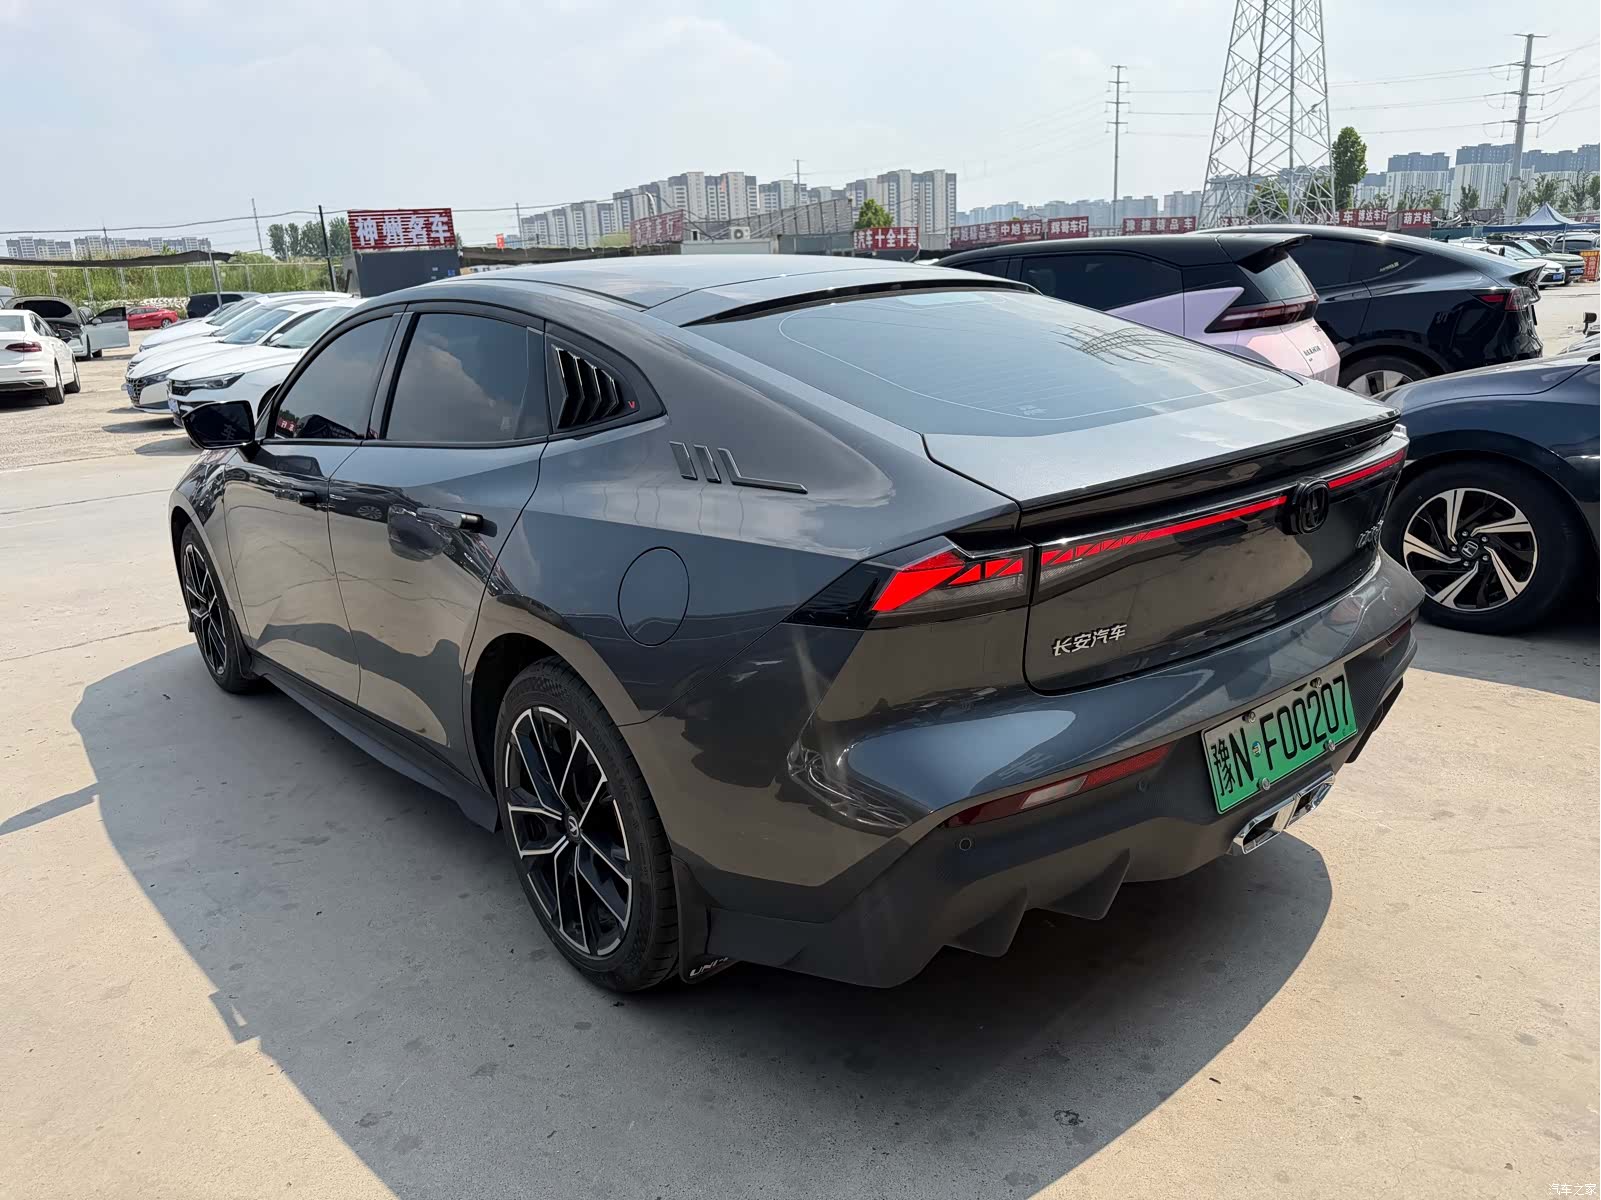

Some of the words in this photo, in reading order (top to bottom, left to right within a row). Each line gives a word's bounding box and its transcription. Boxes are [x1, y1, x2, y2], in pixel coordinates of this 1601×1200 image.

[1403, 211, 1432, 225] 葫芦娃
[875, 228, 918, 248] 十全十美
[1053, 624, 1127, 656] 长安汽车
